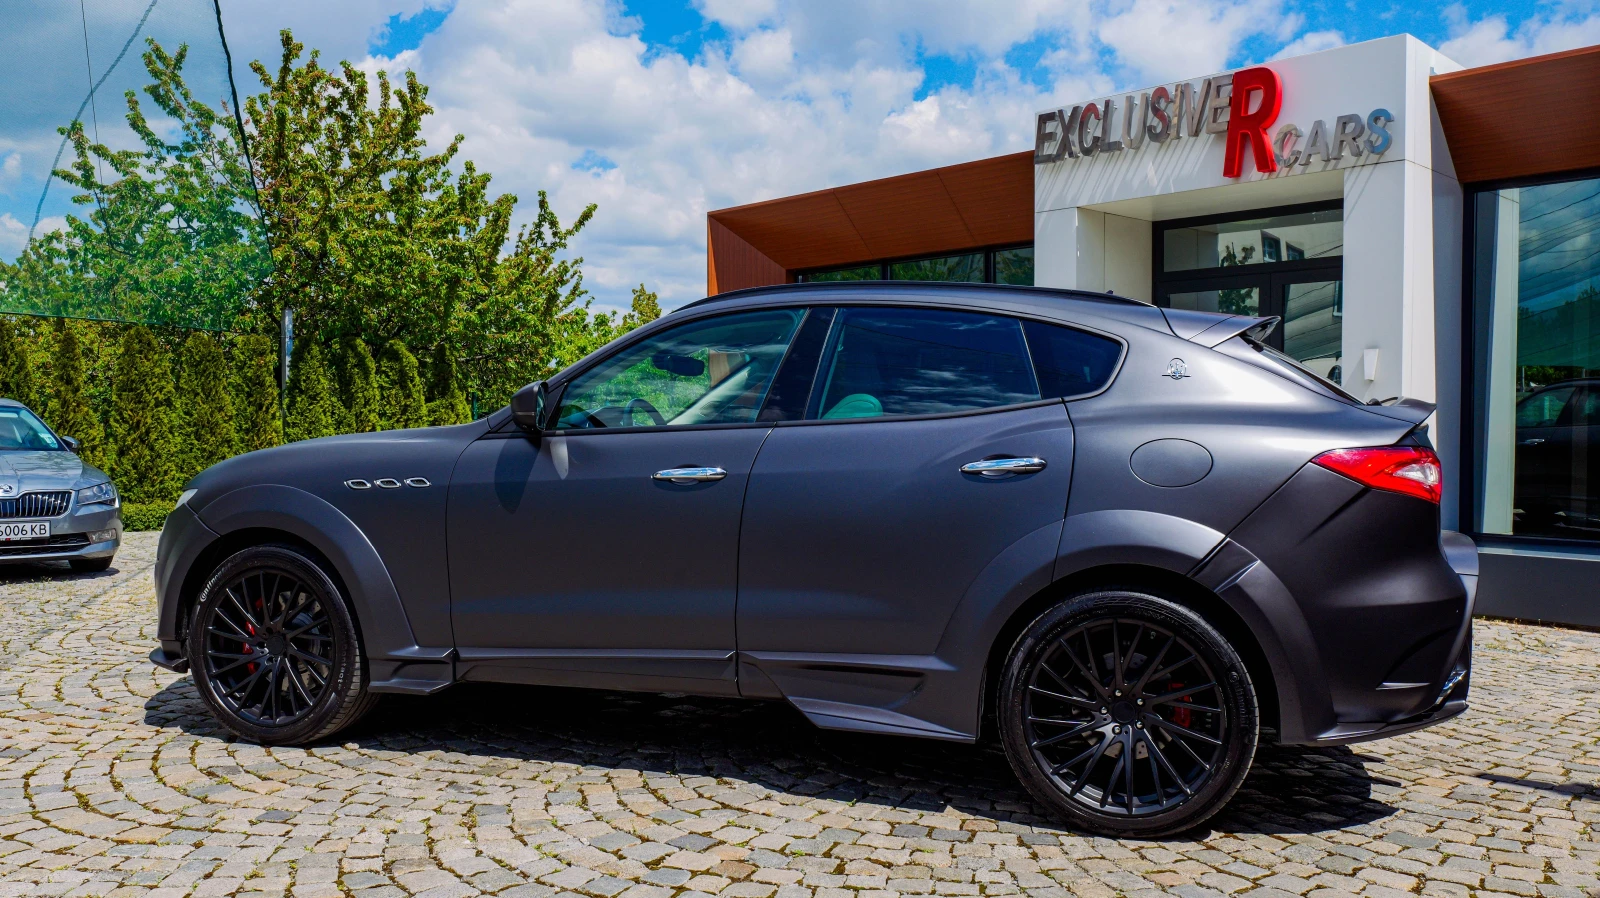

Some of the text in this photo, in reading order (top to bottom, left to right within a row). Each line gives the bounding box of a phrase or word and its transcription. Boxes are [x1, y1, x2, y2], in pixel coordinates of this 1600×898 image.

[1034, 66, 1395, 178] EXCLUSIVE R CARS
